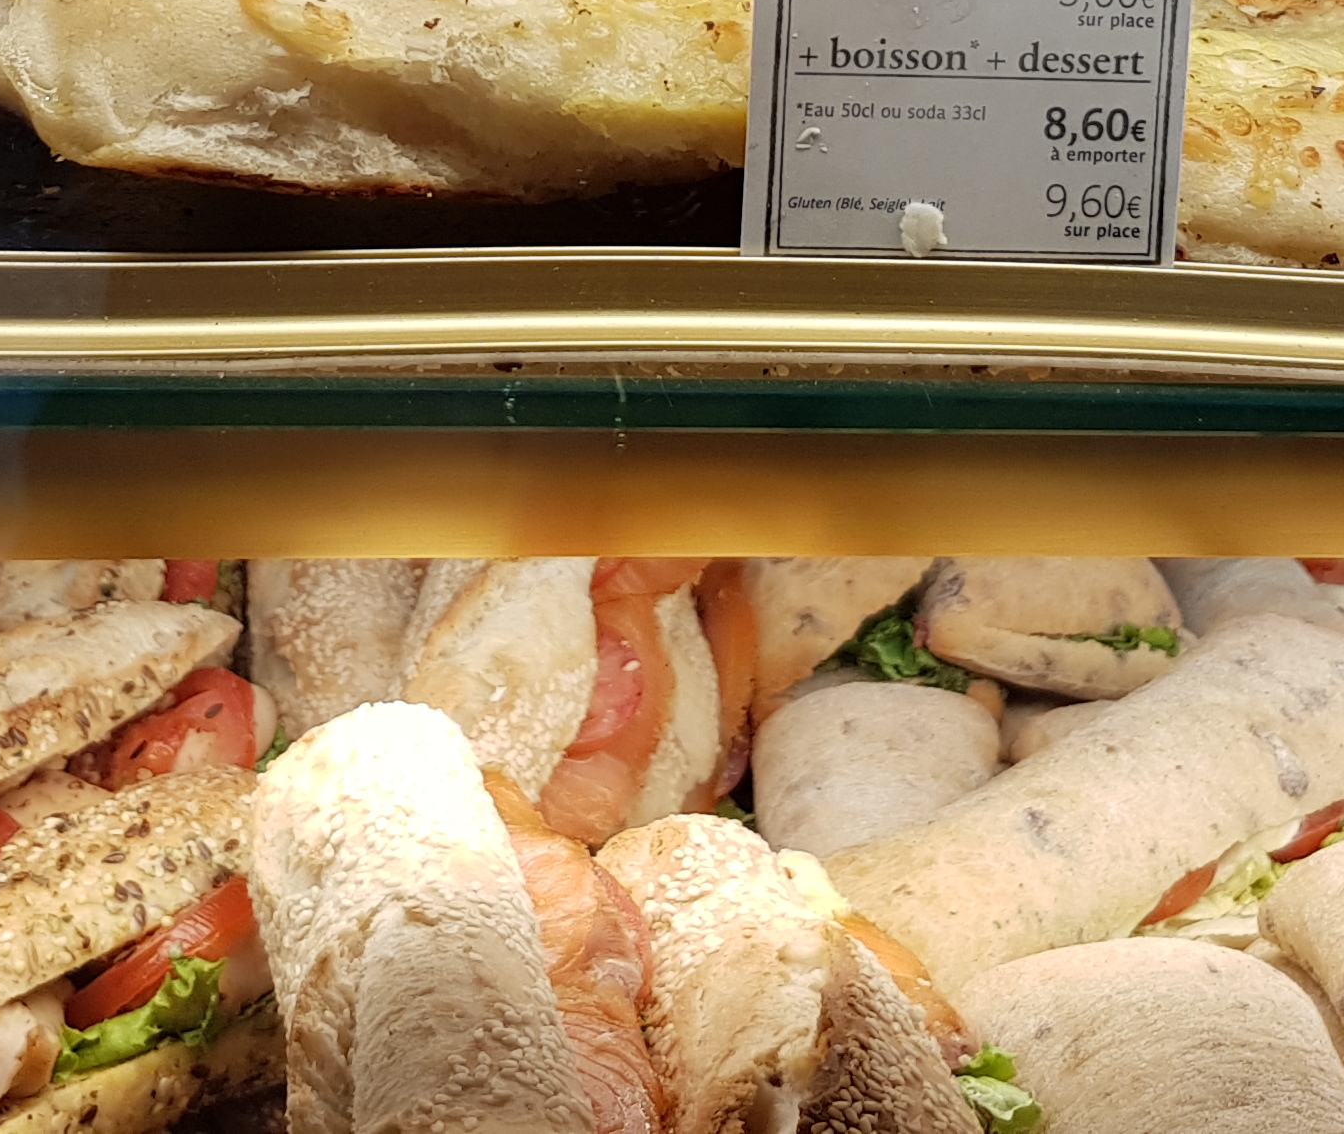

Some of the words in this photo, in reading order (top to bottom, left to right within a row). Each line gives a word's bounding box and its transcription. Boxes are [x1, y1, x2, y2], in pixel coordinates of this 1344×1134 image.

[1077, 14, 1104, 27] sur
[1110, 12, 1155, 31] place
[798, 46, 819, 68] +
[986, 51, 1007, 72] +
[1018, 41, 1145, 76] dessert
[841, 102, 875, 119] 50cl
[881, 105, 902, 119] ou
[907, 104, 946, 120] soda
[952, 105, 986, 122] 33cl
[1043, 106, 1147, 147] 8,60€
[1050, 146, 1061, 161] à
[1066, 149, 1146, 165] emporter
[788, 196, 832, 209] Gluten
[1045, 183, 1142, 223] 9,60€
[1064, 225, 1091, 237] sur
[1096, 222, 1141, 241] place
